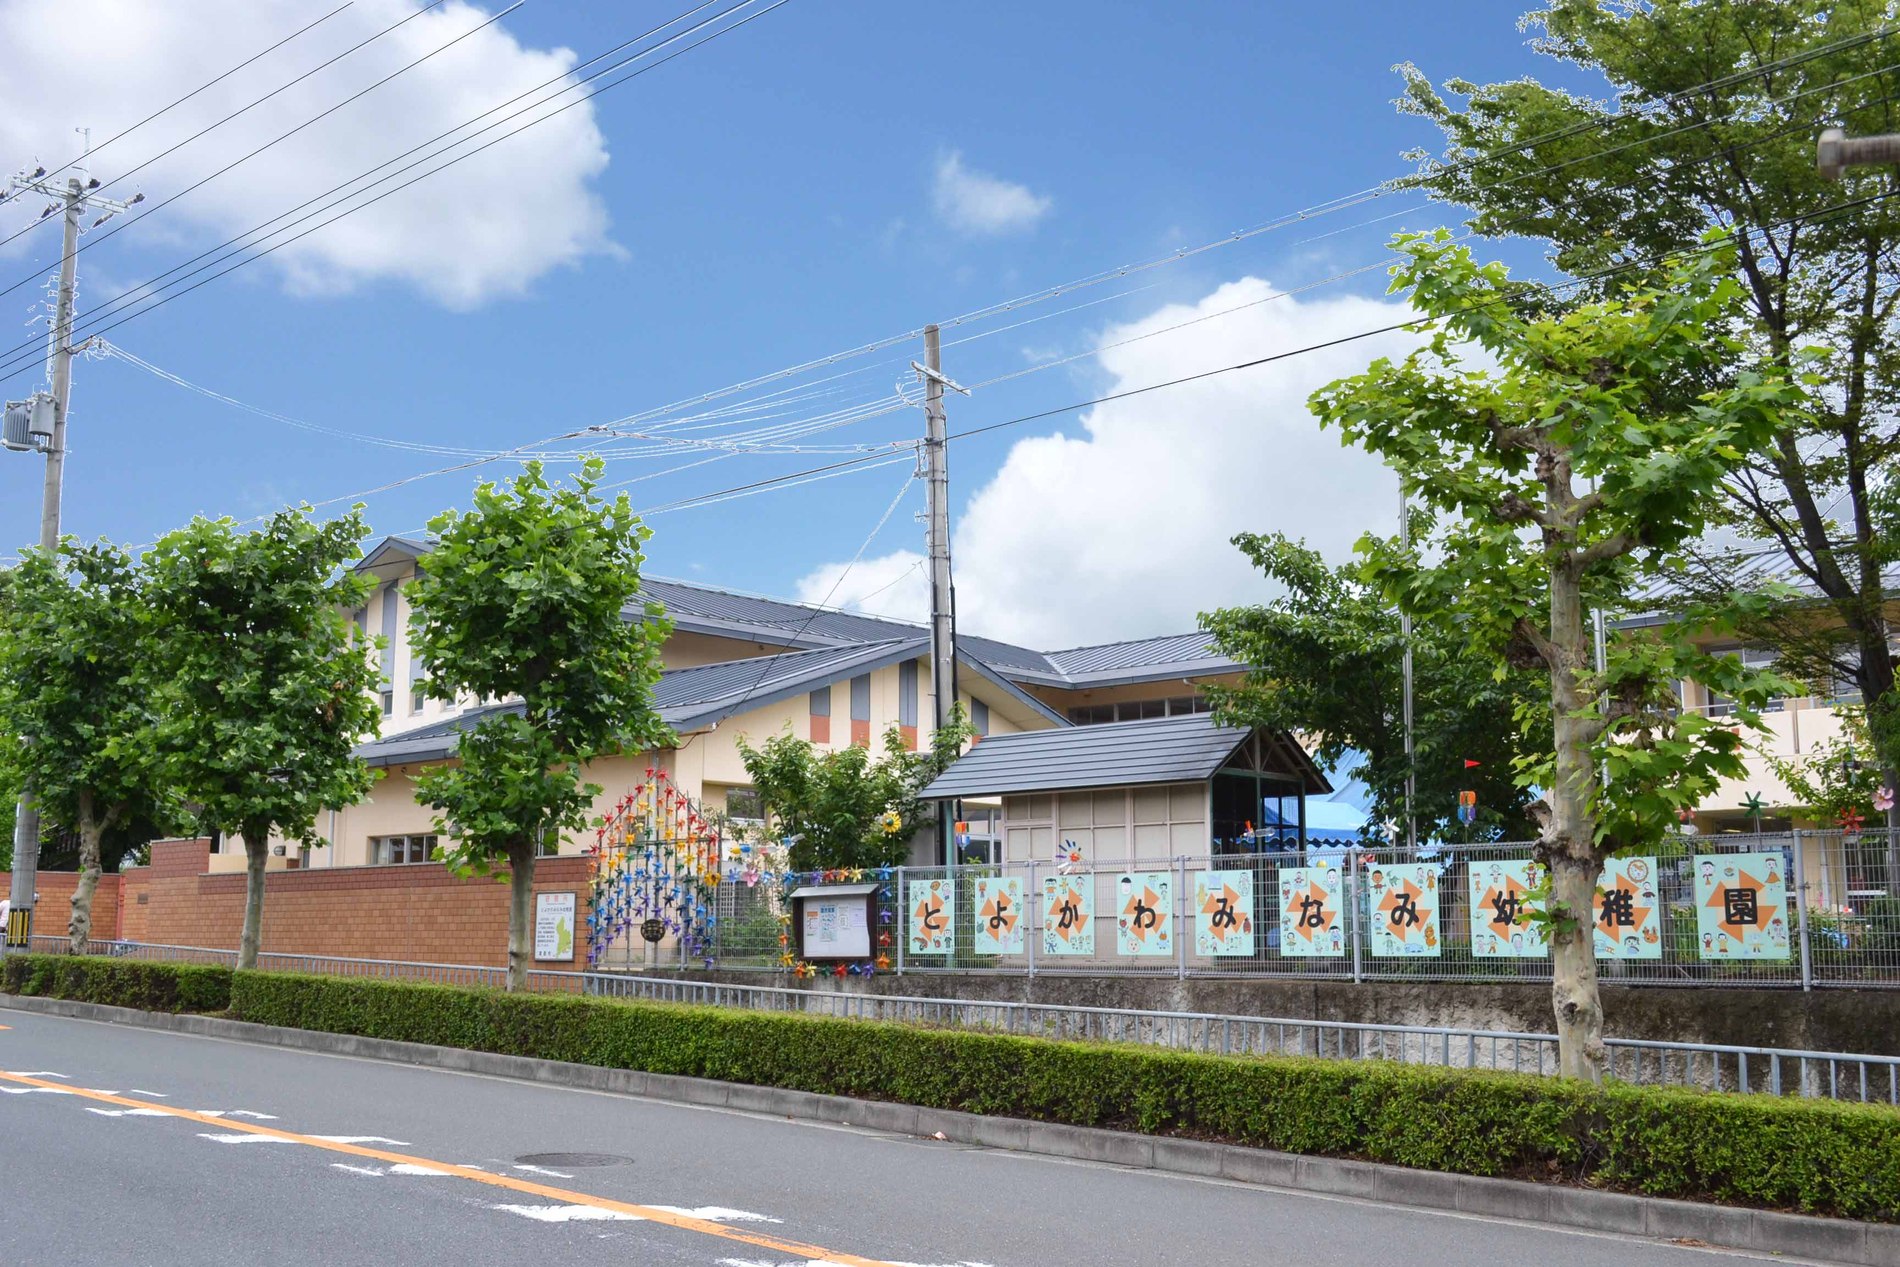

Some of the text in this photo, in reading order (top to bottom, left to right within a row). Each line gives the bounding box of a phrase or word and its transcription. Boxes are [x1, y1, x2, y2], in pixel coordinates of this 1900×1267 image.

[924, 902, 941, 930] と
[989, 900, 1008, 930] よ
[1058, 900, 1079, 929] か
[1133, 898, 1156, 929] わ
[1212, 897, 1237, 929] み
[1298, 894, 1325, 928] な
[1390, 893, 1420, 928] み
[1599, 888, 1635, 927] 稚
[1723, 887, 1758, 925] 園
